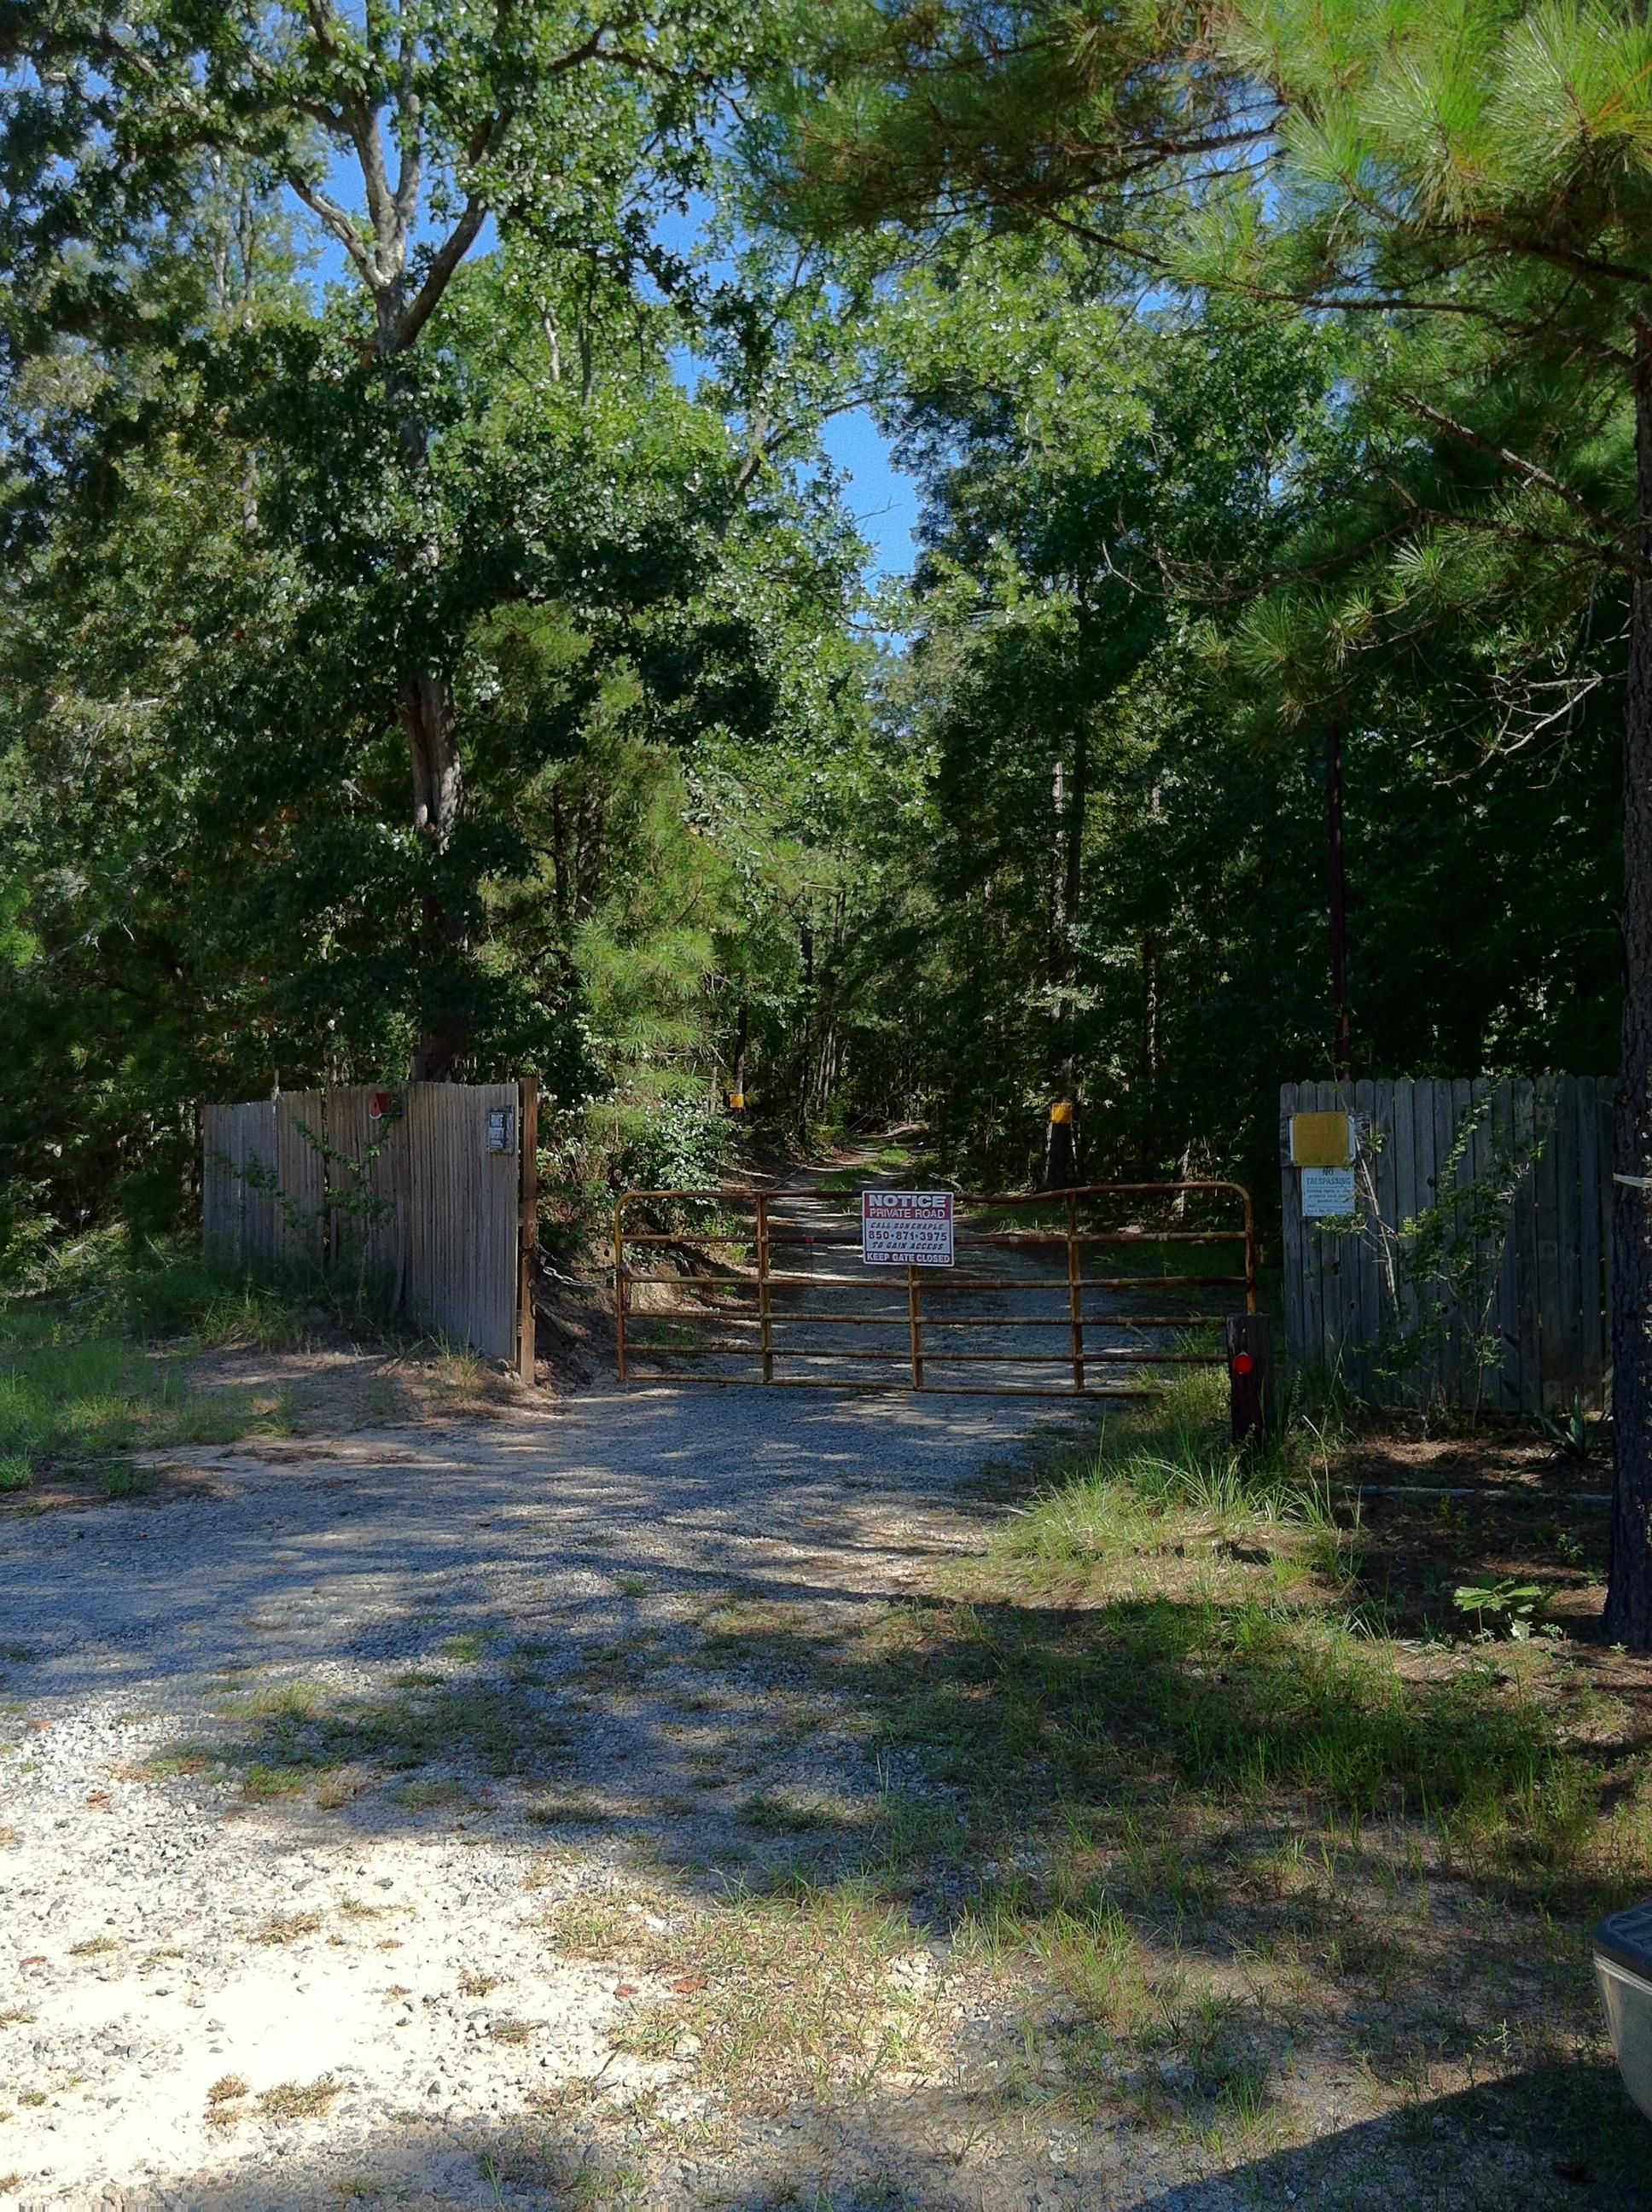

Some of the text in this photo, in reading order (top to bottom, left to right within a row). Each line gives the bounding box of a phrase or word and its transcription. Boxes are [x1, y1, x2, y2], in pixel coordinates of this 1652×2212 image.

[1323, 1167, 1334, 1176] NO
[1306, 1177, 1351, 1185] TRESPASSING
[869, 1195, 946, 1208] NOTICE
[870, 1208, 945, 1219] PRIVATE ROAD
[867, 1253, 950, 1263] KEEP GATE CLOSED
